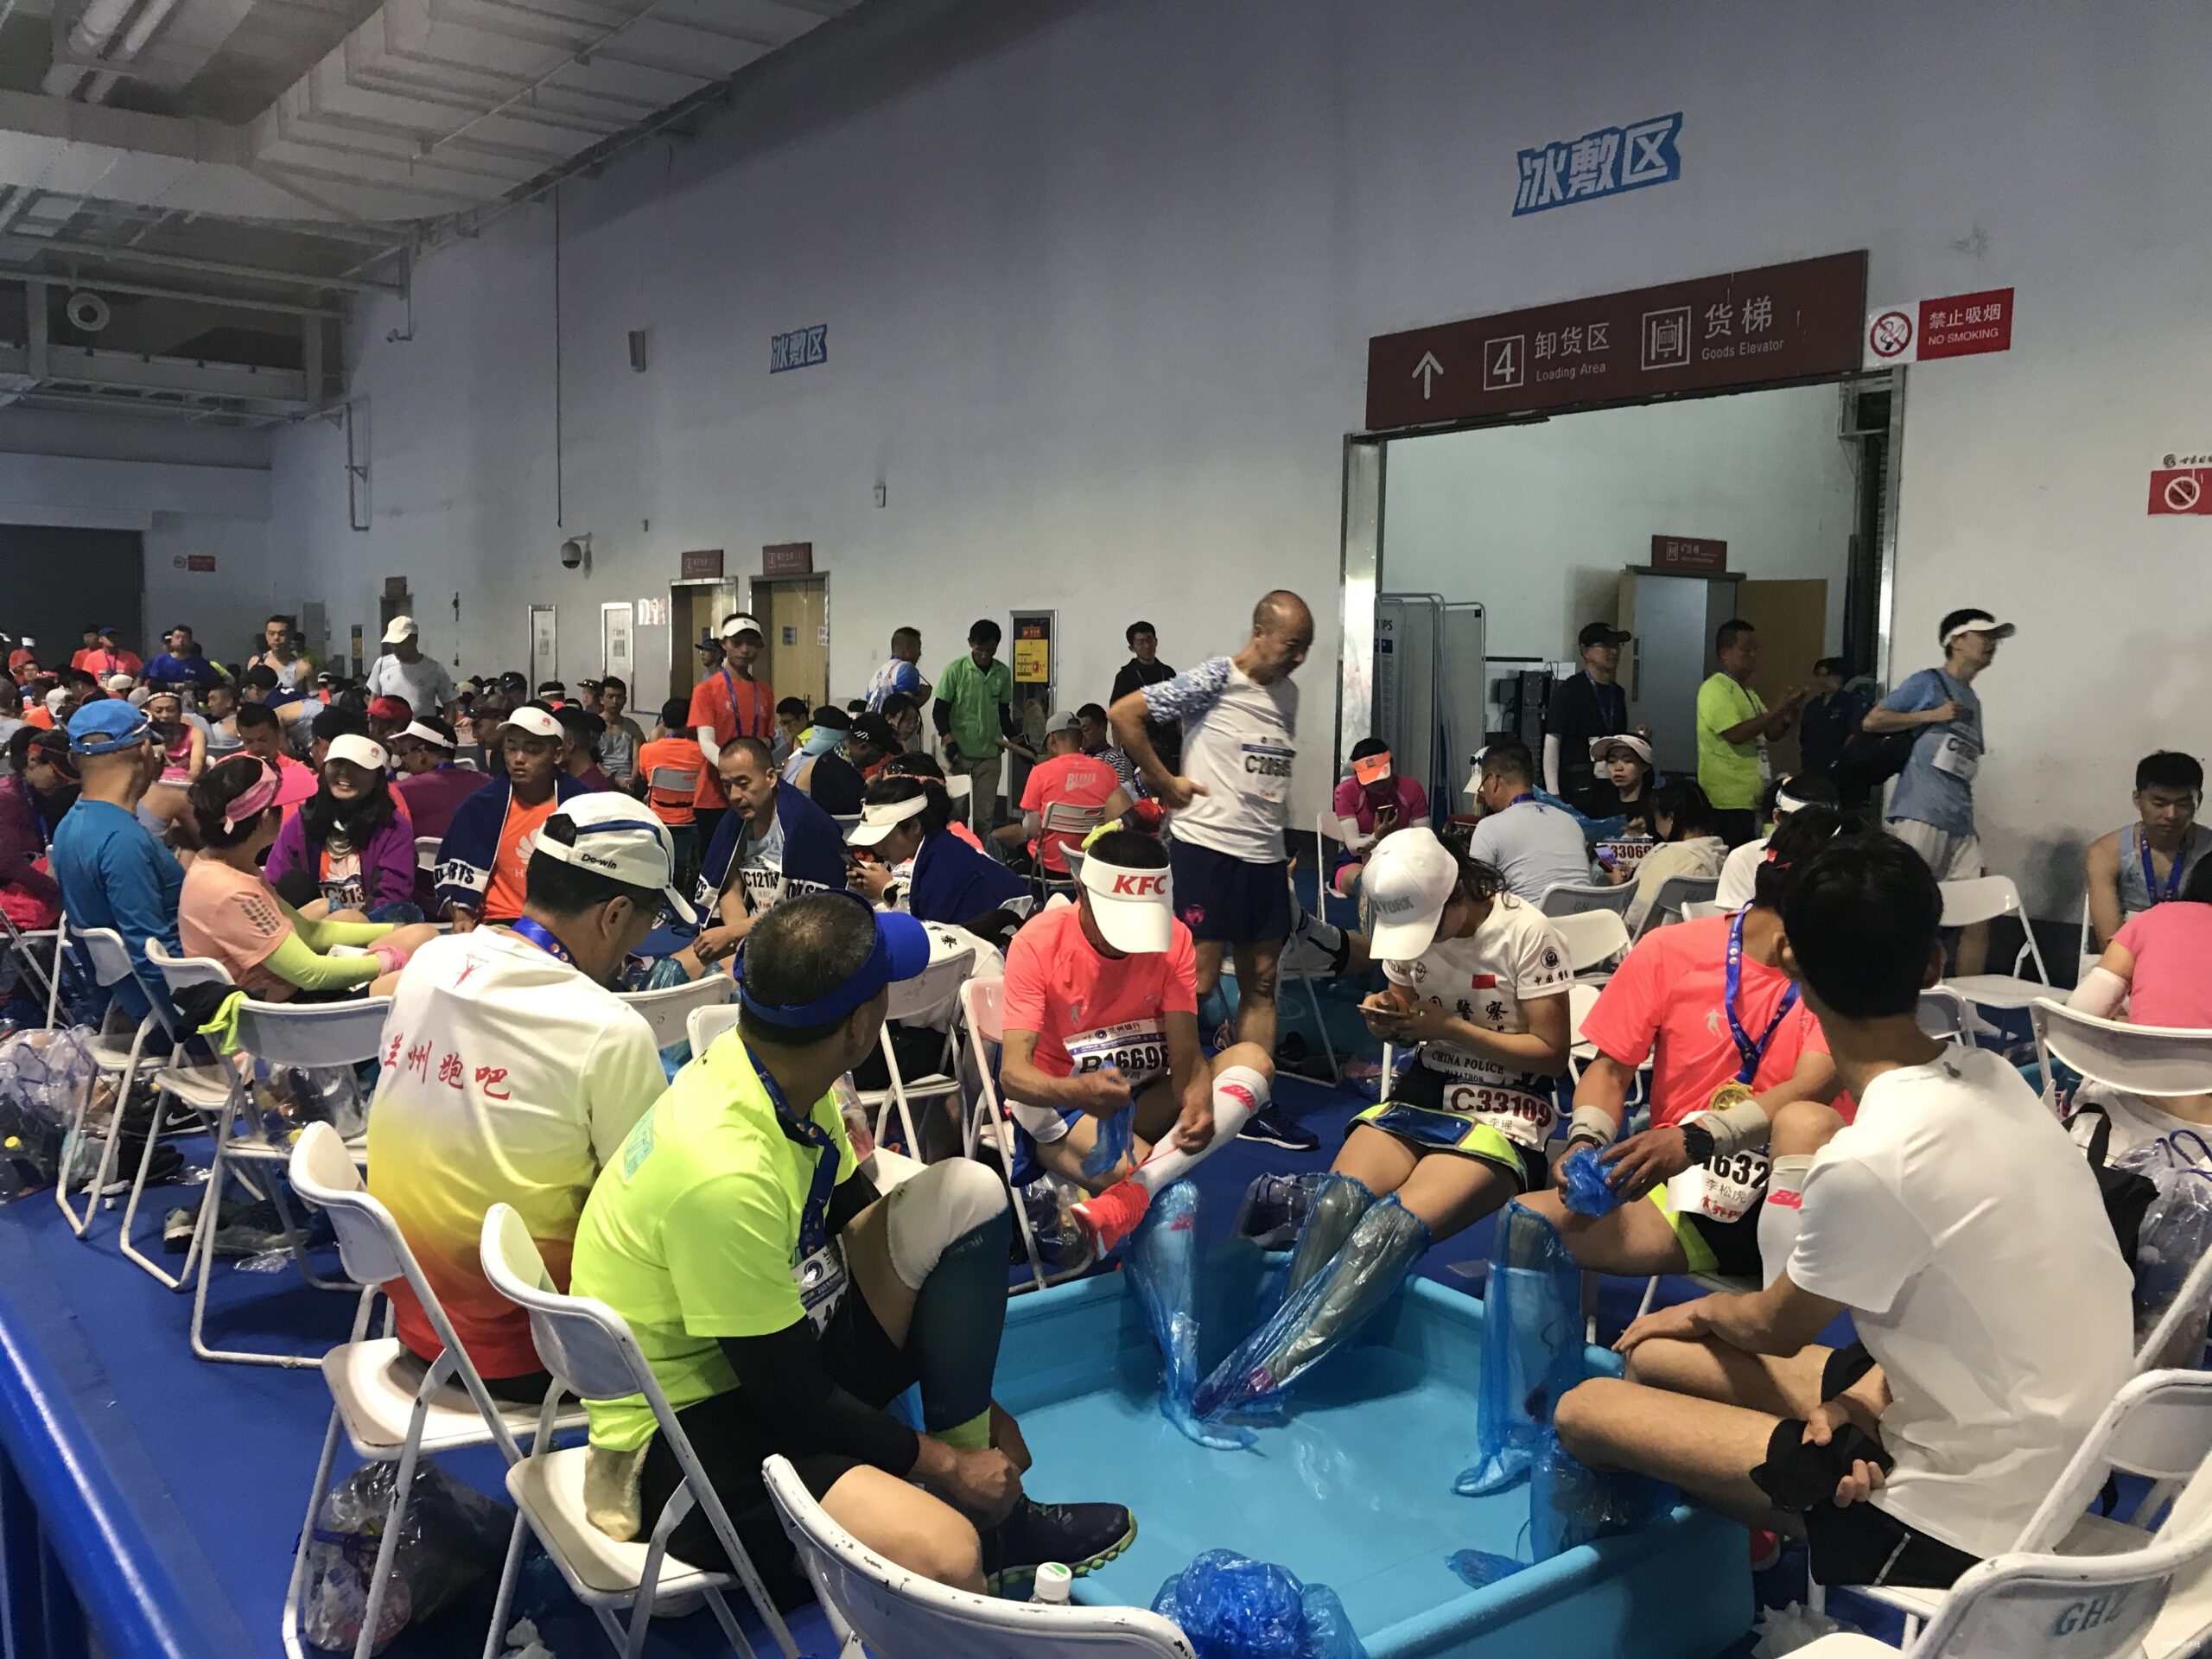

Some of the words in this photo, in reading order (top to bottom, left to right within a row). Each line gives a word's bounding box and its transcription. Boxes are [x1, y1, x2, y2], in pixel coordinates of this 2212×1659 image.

[1517, 119, 1674, 209] 冰敷区
[1704, 296, 1772, 339] 货梯
[1929, 304, 2001, 329] 禁止吸烟
[771, 327, 825, 369] 冰敷区
[1535, 322, 1610, 359] 卸货区
[1701, 346, 1735, 360] Goods
[1740, 338, 1784, 356] Elevator
[1929, 334, 1945, 346] NO
[1947, 328, 1999, 343] SMOKING
[1492, 342, 1516, 383] 4
[1536, 364, 1576, 382] Loading
[1580, 361, 1606, 375] Area
[582, 854, 617, 869] Do-win
[1112, 874, 1168, 896] KFC
[384, 1033, 511, 1100] 兰州跑吧
[1432, 1051, 1461, 1066] CHINA
[1464, 1058, 1506, 1075] POLICE
[1451, 1087, 1552, 1128] C33109
